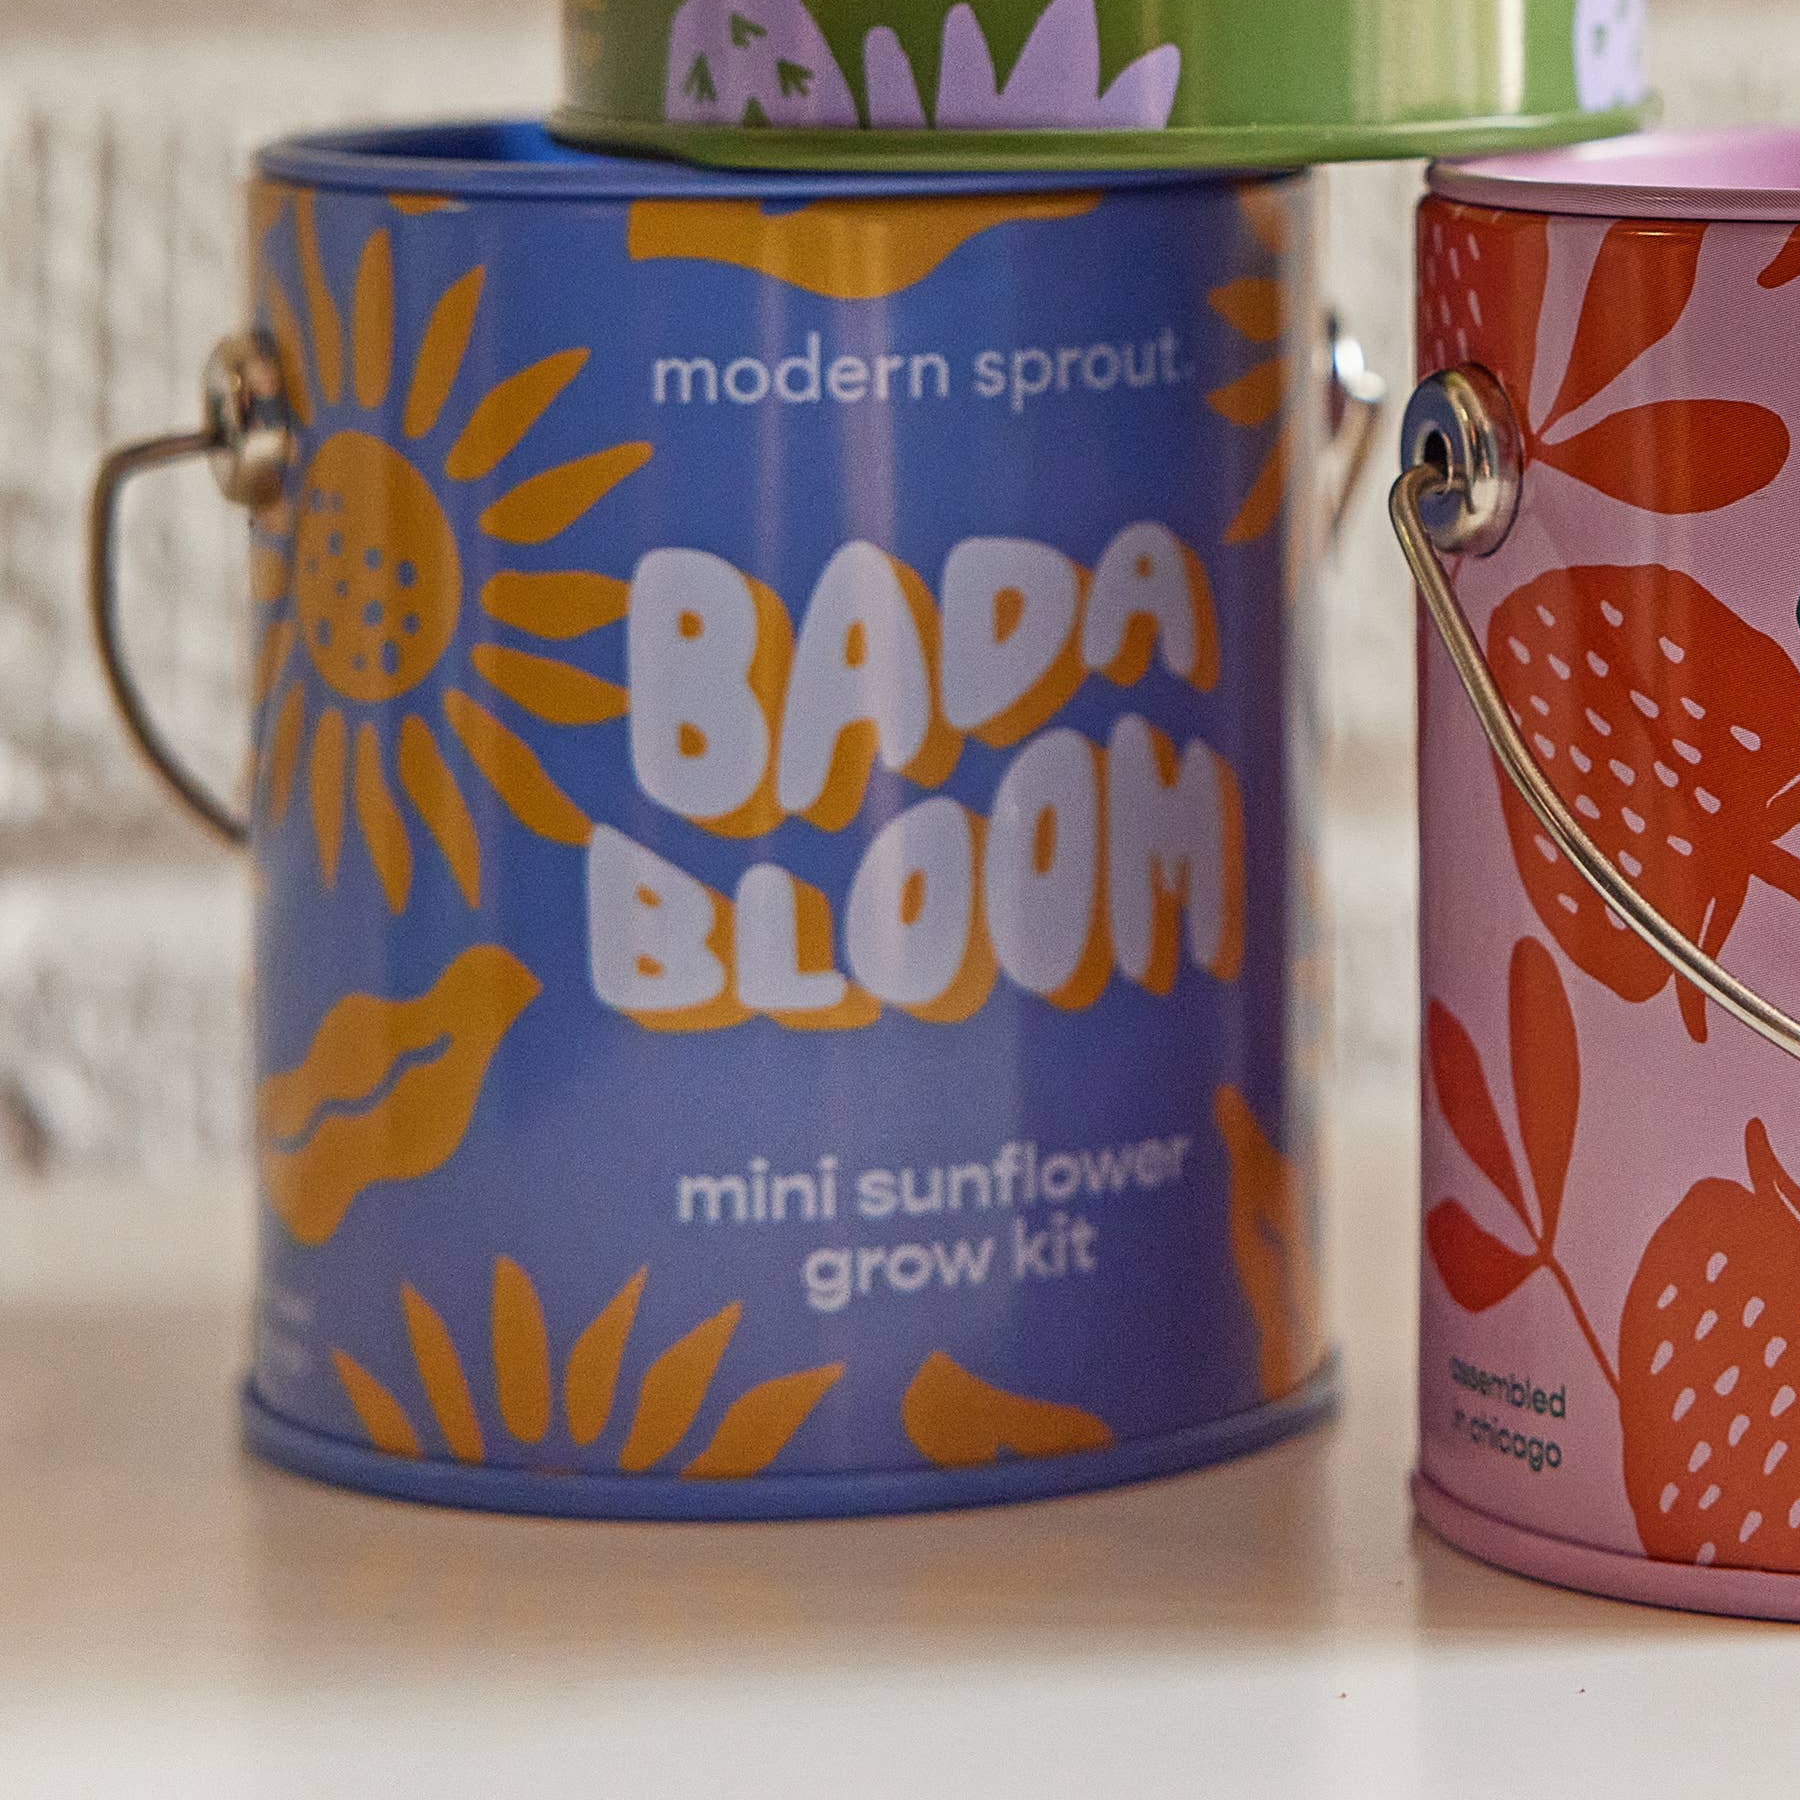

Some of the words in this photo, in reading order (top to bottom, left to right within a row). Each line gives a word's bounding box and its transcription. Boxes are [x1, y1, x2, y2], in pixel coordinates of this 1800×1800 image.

[652, 332, 950, 403] modern
[627, 520, 1219, 839] BADA
[587, 713, 1245, 1031] BLOOM
[676, 1155, 840, 1223] mini
[858, 1134, 1193, 1218] sunflower
[804, 1234, 996, 1313] grow
[1010, 1216, 1099, 1282] kit
